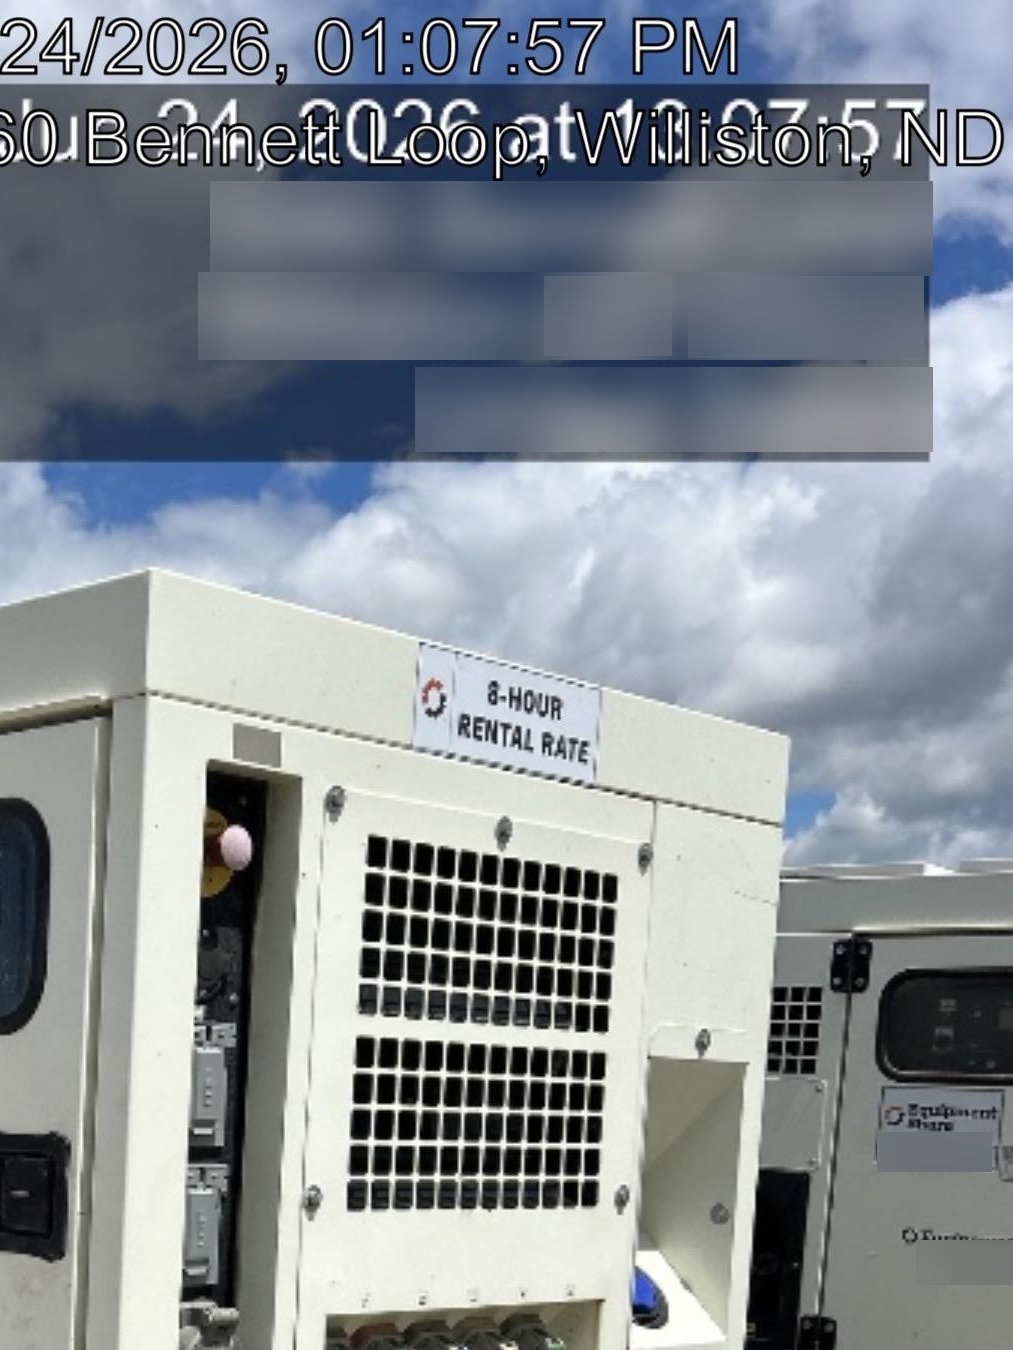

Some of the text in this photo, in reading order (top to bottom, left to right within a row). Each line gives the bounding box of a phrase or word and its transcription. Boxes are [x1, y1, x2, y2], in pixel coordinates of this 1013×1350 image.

[487, 679, 564, 721] 8-HOUR
[457, 712, 590, 764] RENTAL RATE
